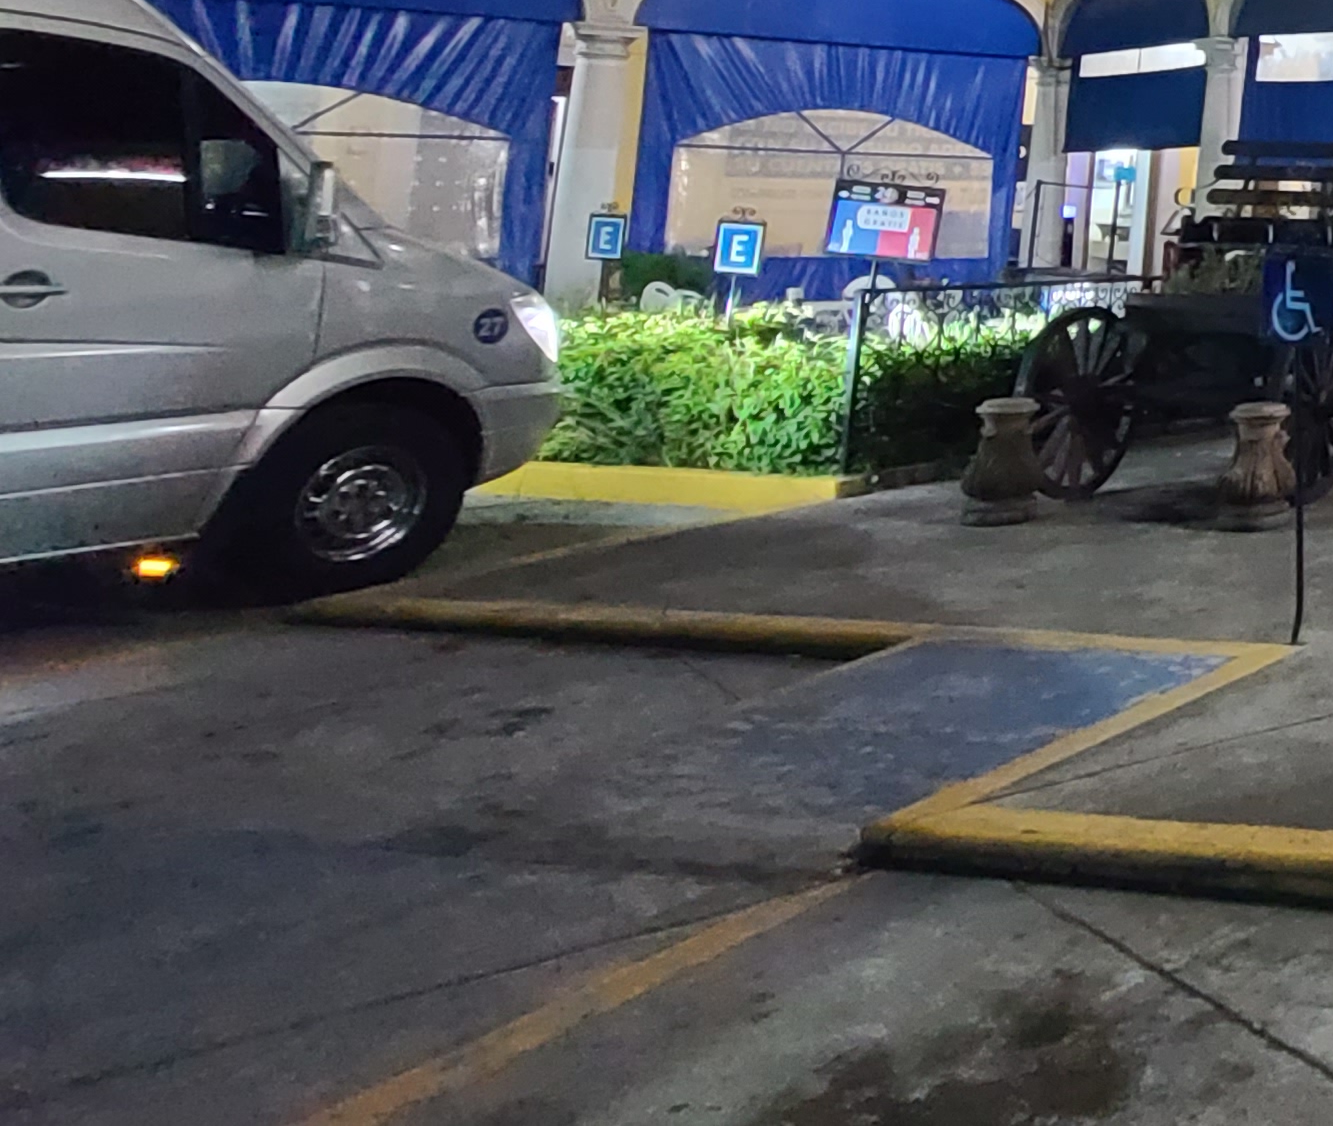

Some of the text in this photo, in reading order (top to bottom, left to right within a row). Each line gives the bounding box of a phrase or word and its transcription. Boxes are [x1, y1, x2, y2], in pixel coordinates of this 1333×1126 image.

[599, 225, 612, 251] E
[729, 234, 749, 262] E
[479, 316, 504, 337] 27
